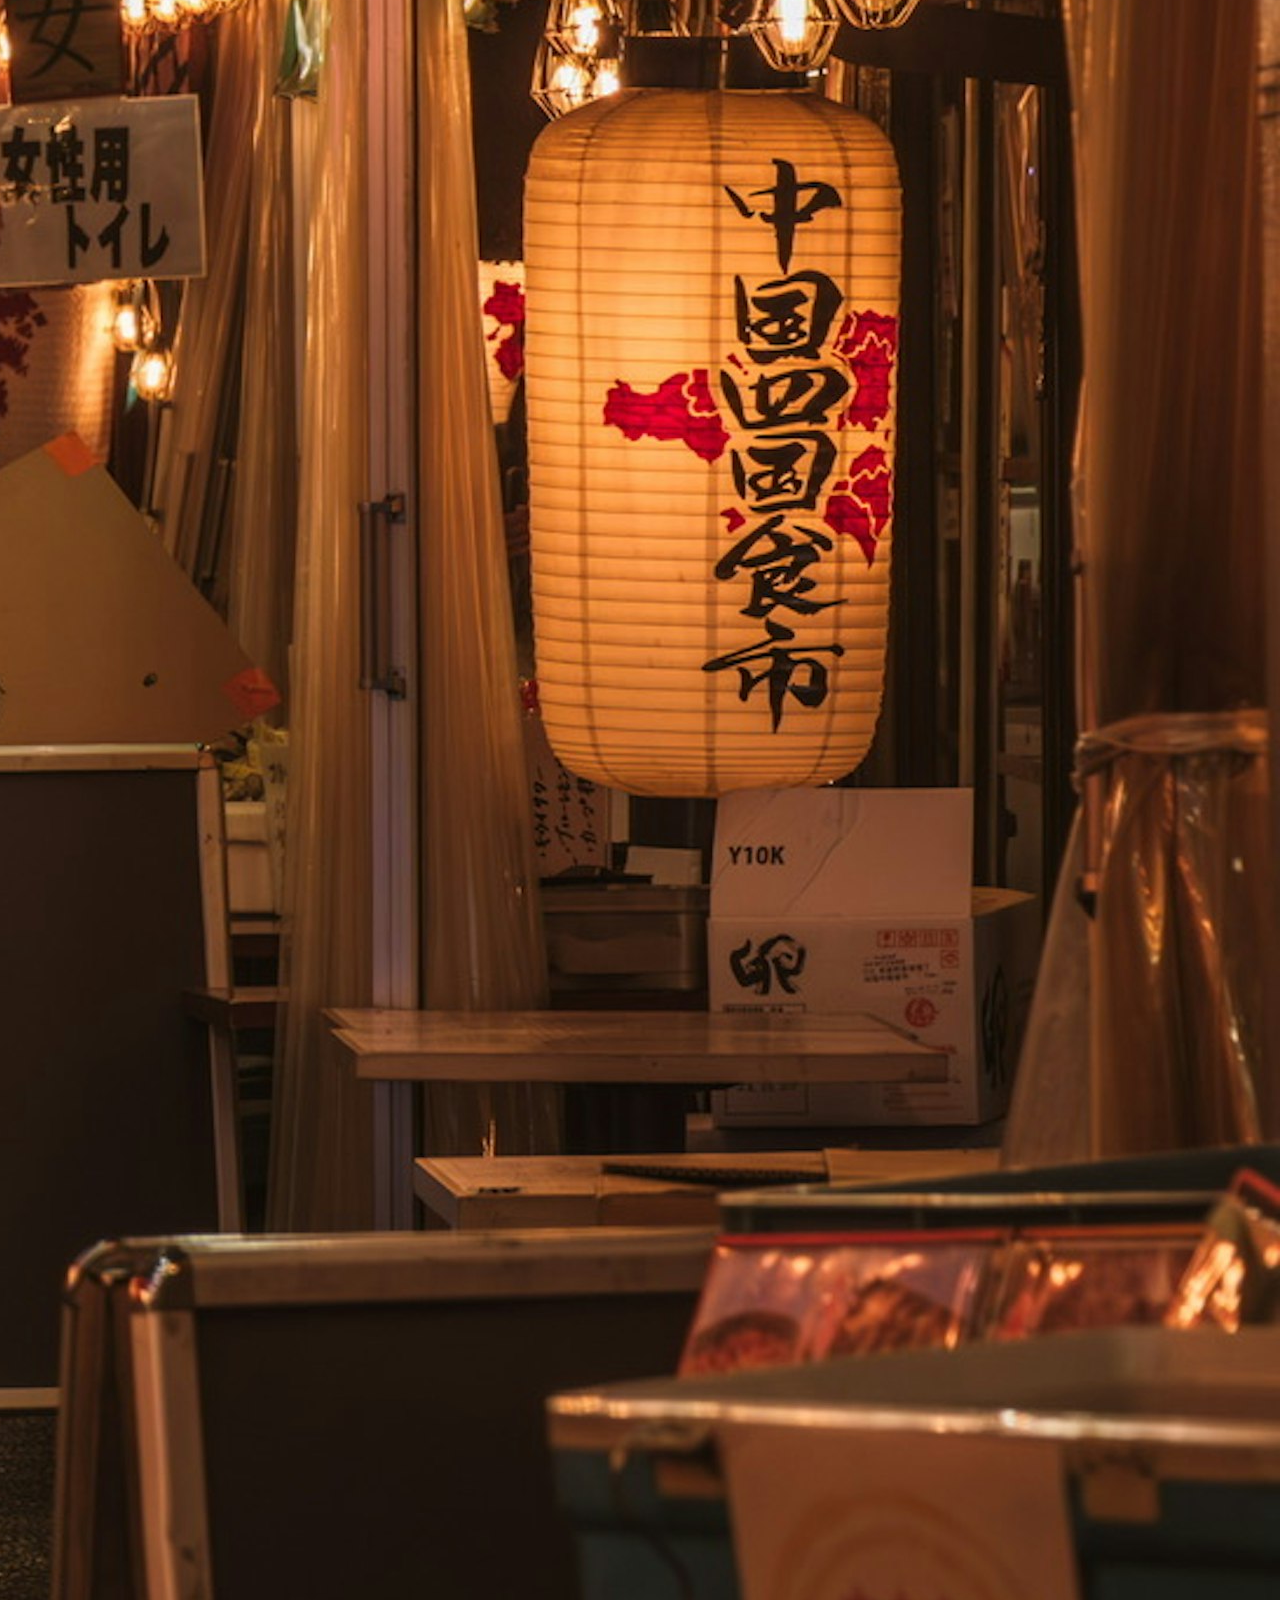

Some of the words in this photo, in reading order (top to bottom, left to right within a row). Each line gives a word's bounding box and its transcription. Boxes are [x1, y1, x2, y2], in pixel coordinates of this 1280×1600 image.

[0, 125, 131, 205] 女性用
[67, 202, 171, 270] トイレ
[702, 158, 851, 735] 中国四国食市
[728, 845, 785, 865] Y10K
[729, 932, 807, 996] 卵
